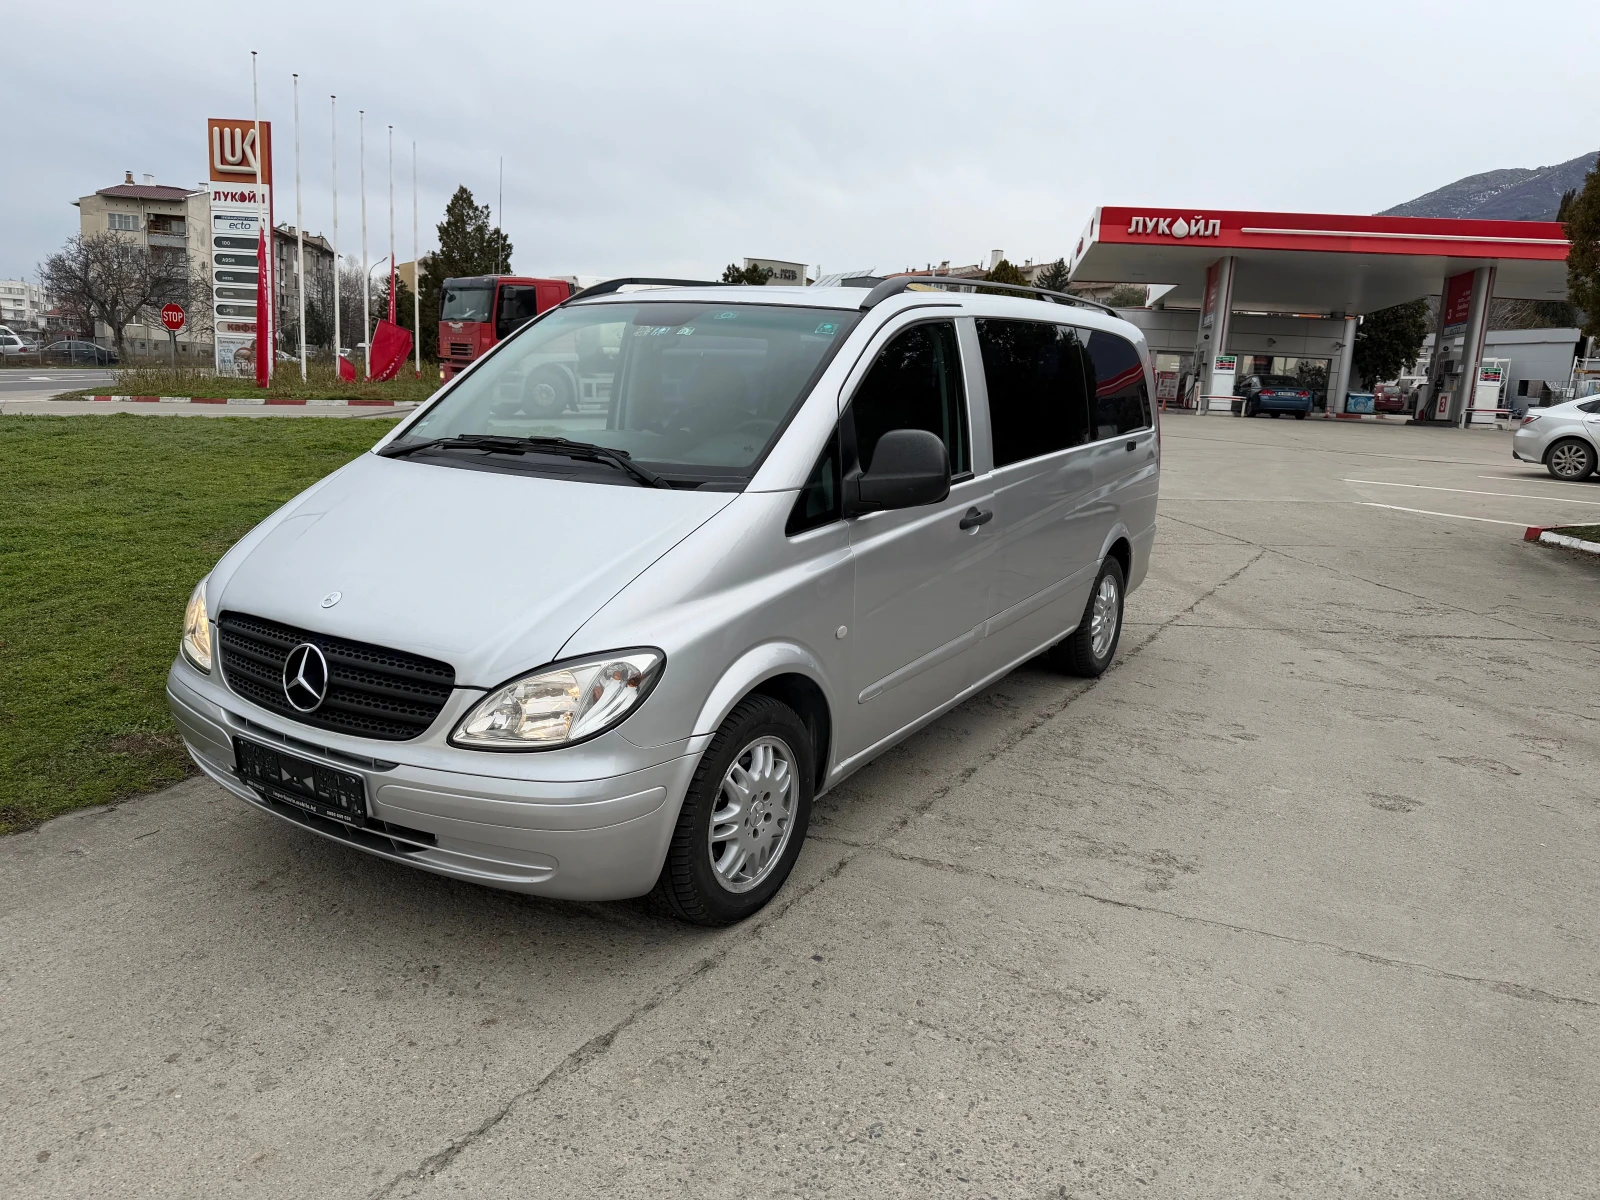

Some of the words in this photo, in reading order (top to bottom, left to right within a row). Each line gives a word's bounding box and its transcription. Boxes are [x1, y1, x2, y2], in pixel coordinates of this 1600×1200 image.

[228, 221, 251, 230] ecto
[1127, 215, 1222, 239] ЛУКОЙЛ
[767, 269, 797, 280] OLIMP
[163, 311, 183, 322] STOP
[227, 323, 257, 333] кафе
[1440, 397, 1445, 411] 3
